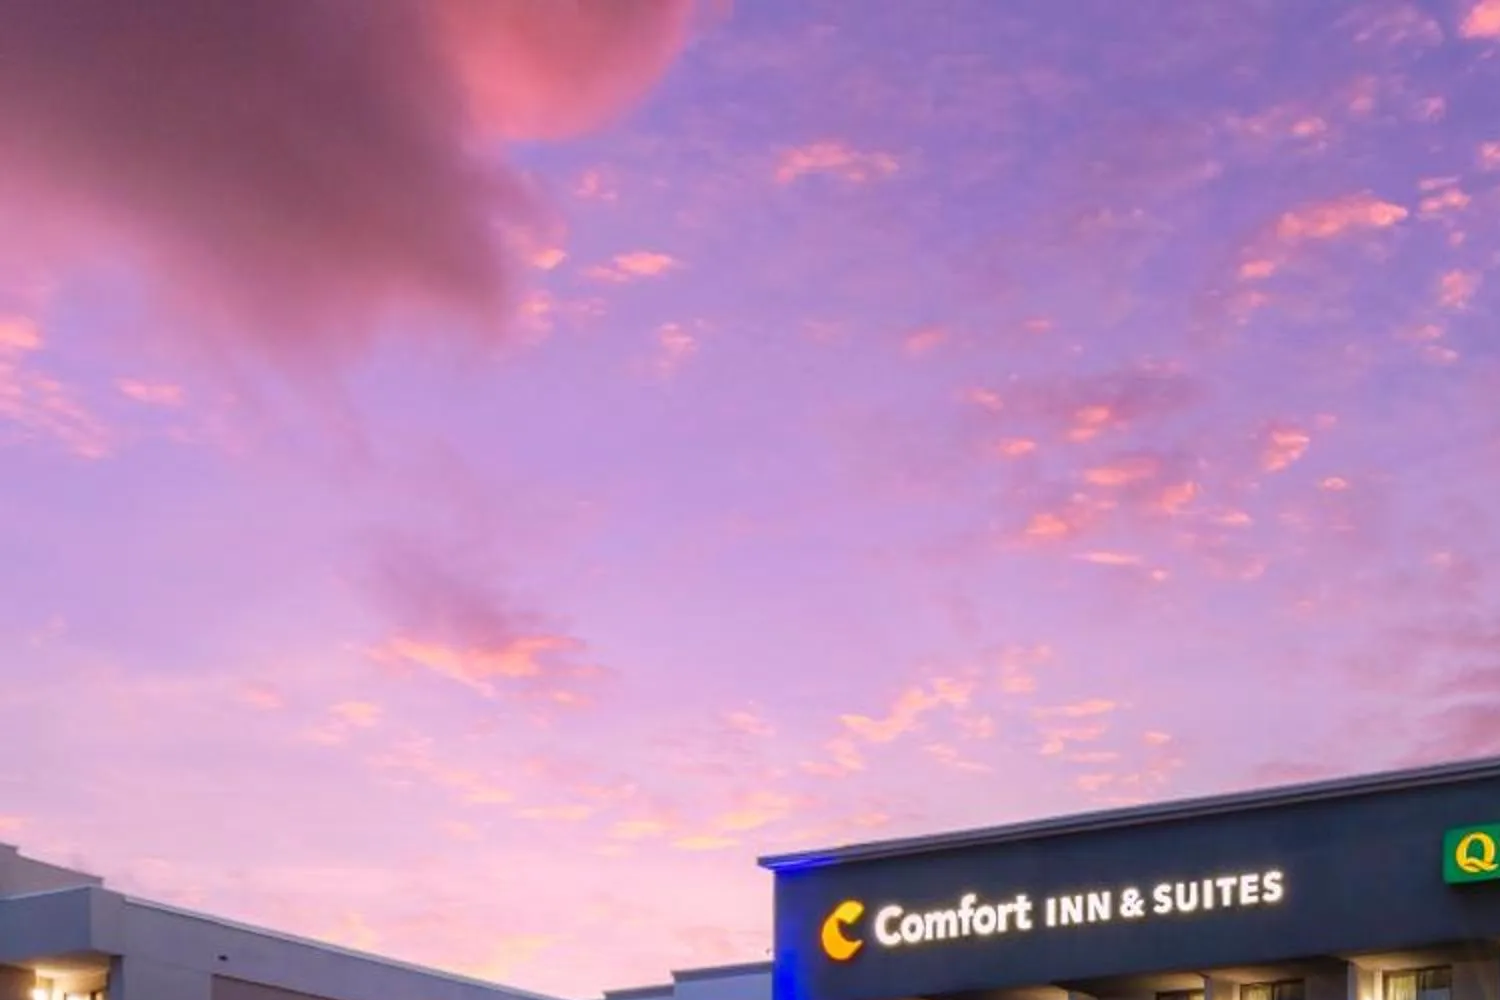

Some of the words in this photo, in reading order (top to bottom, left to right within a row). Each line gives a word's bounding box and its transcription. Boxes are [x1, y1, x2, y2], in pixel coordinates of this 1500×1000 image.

[874, 893, 1033, 946] Comfort
[1045, 890, 1111, 928] INN
[1119, 887, 1146, 919] &
[1151, 870, 1284, 915] SUITES
